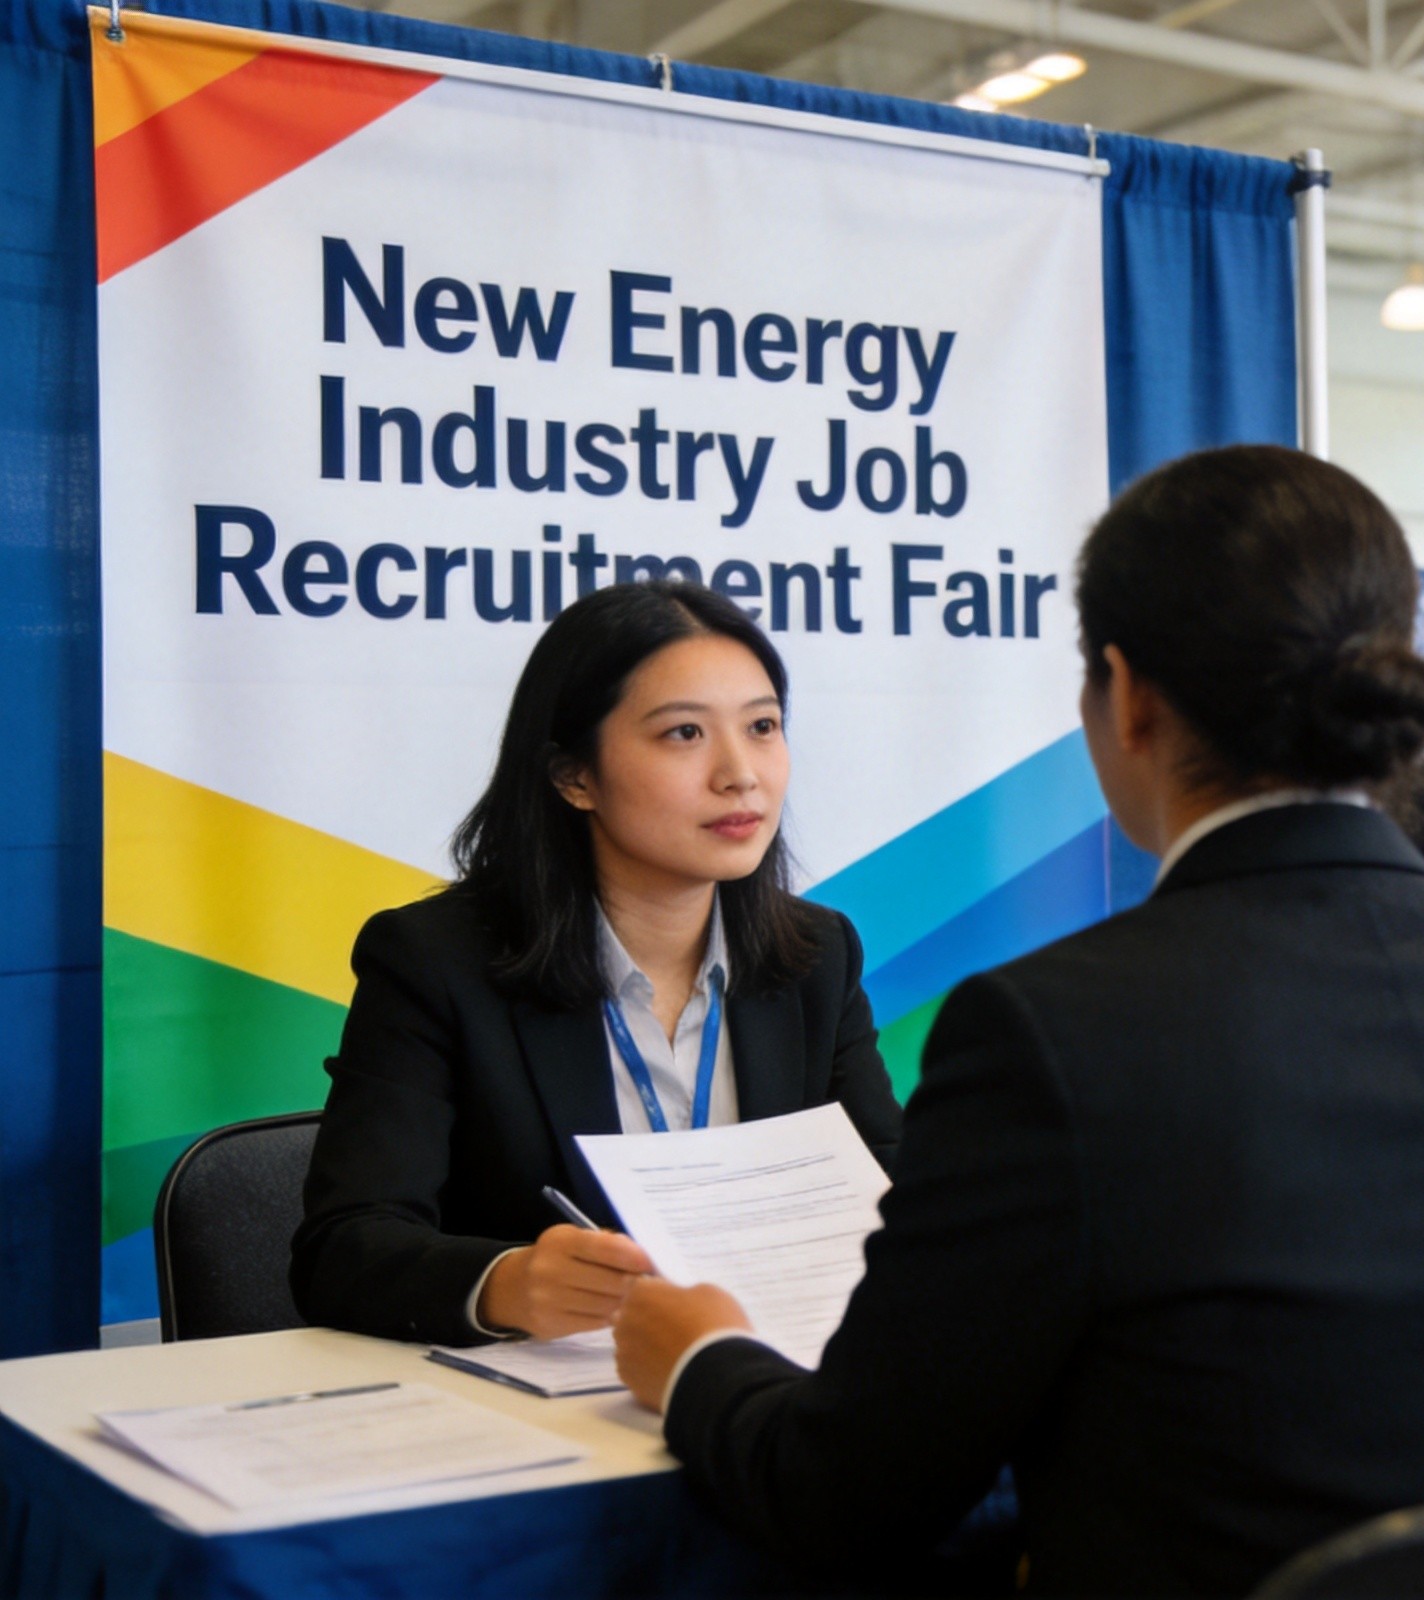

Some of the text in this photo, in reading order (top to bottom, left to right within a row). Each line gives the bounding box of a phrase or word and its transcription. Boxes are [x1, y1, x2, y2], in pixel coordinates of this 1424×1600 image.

[321, 236, 957, 417] New Energy
[319, 375, 968, 529] Industry Job
[891, 544, 1057, 640] Fair
